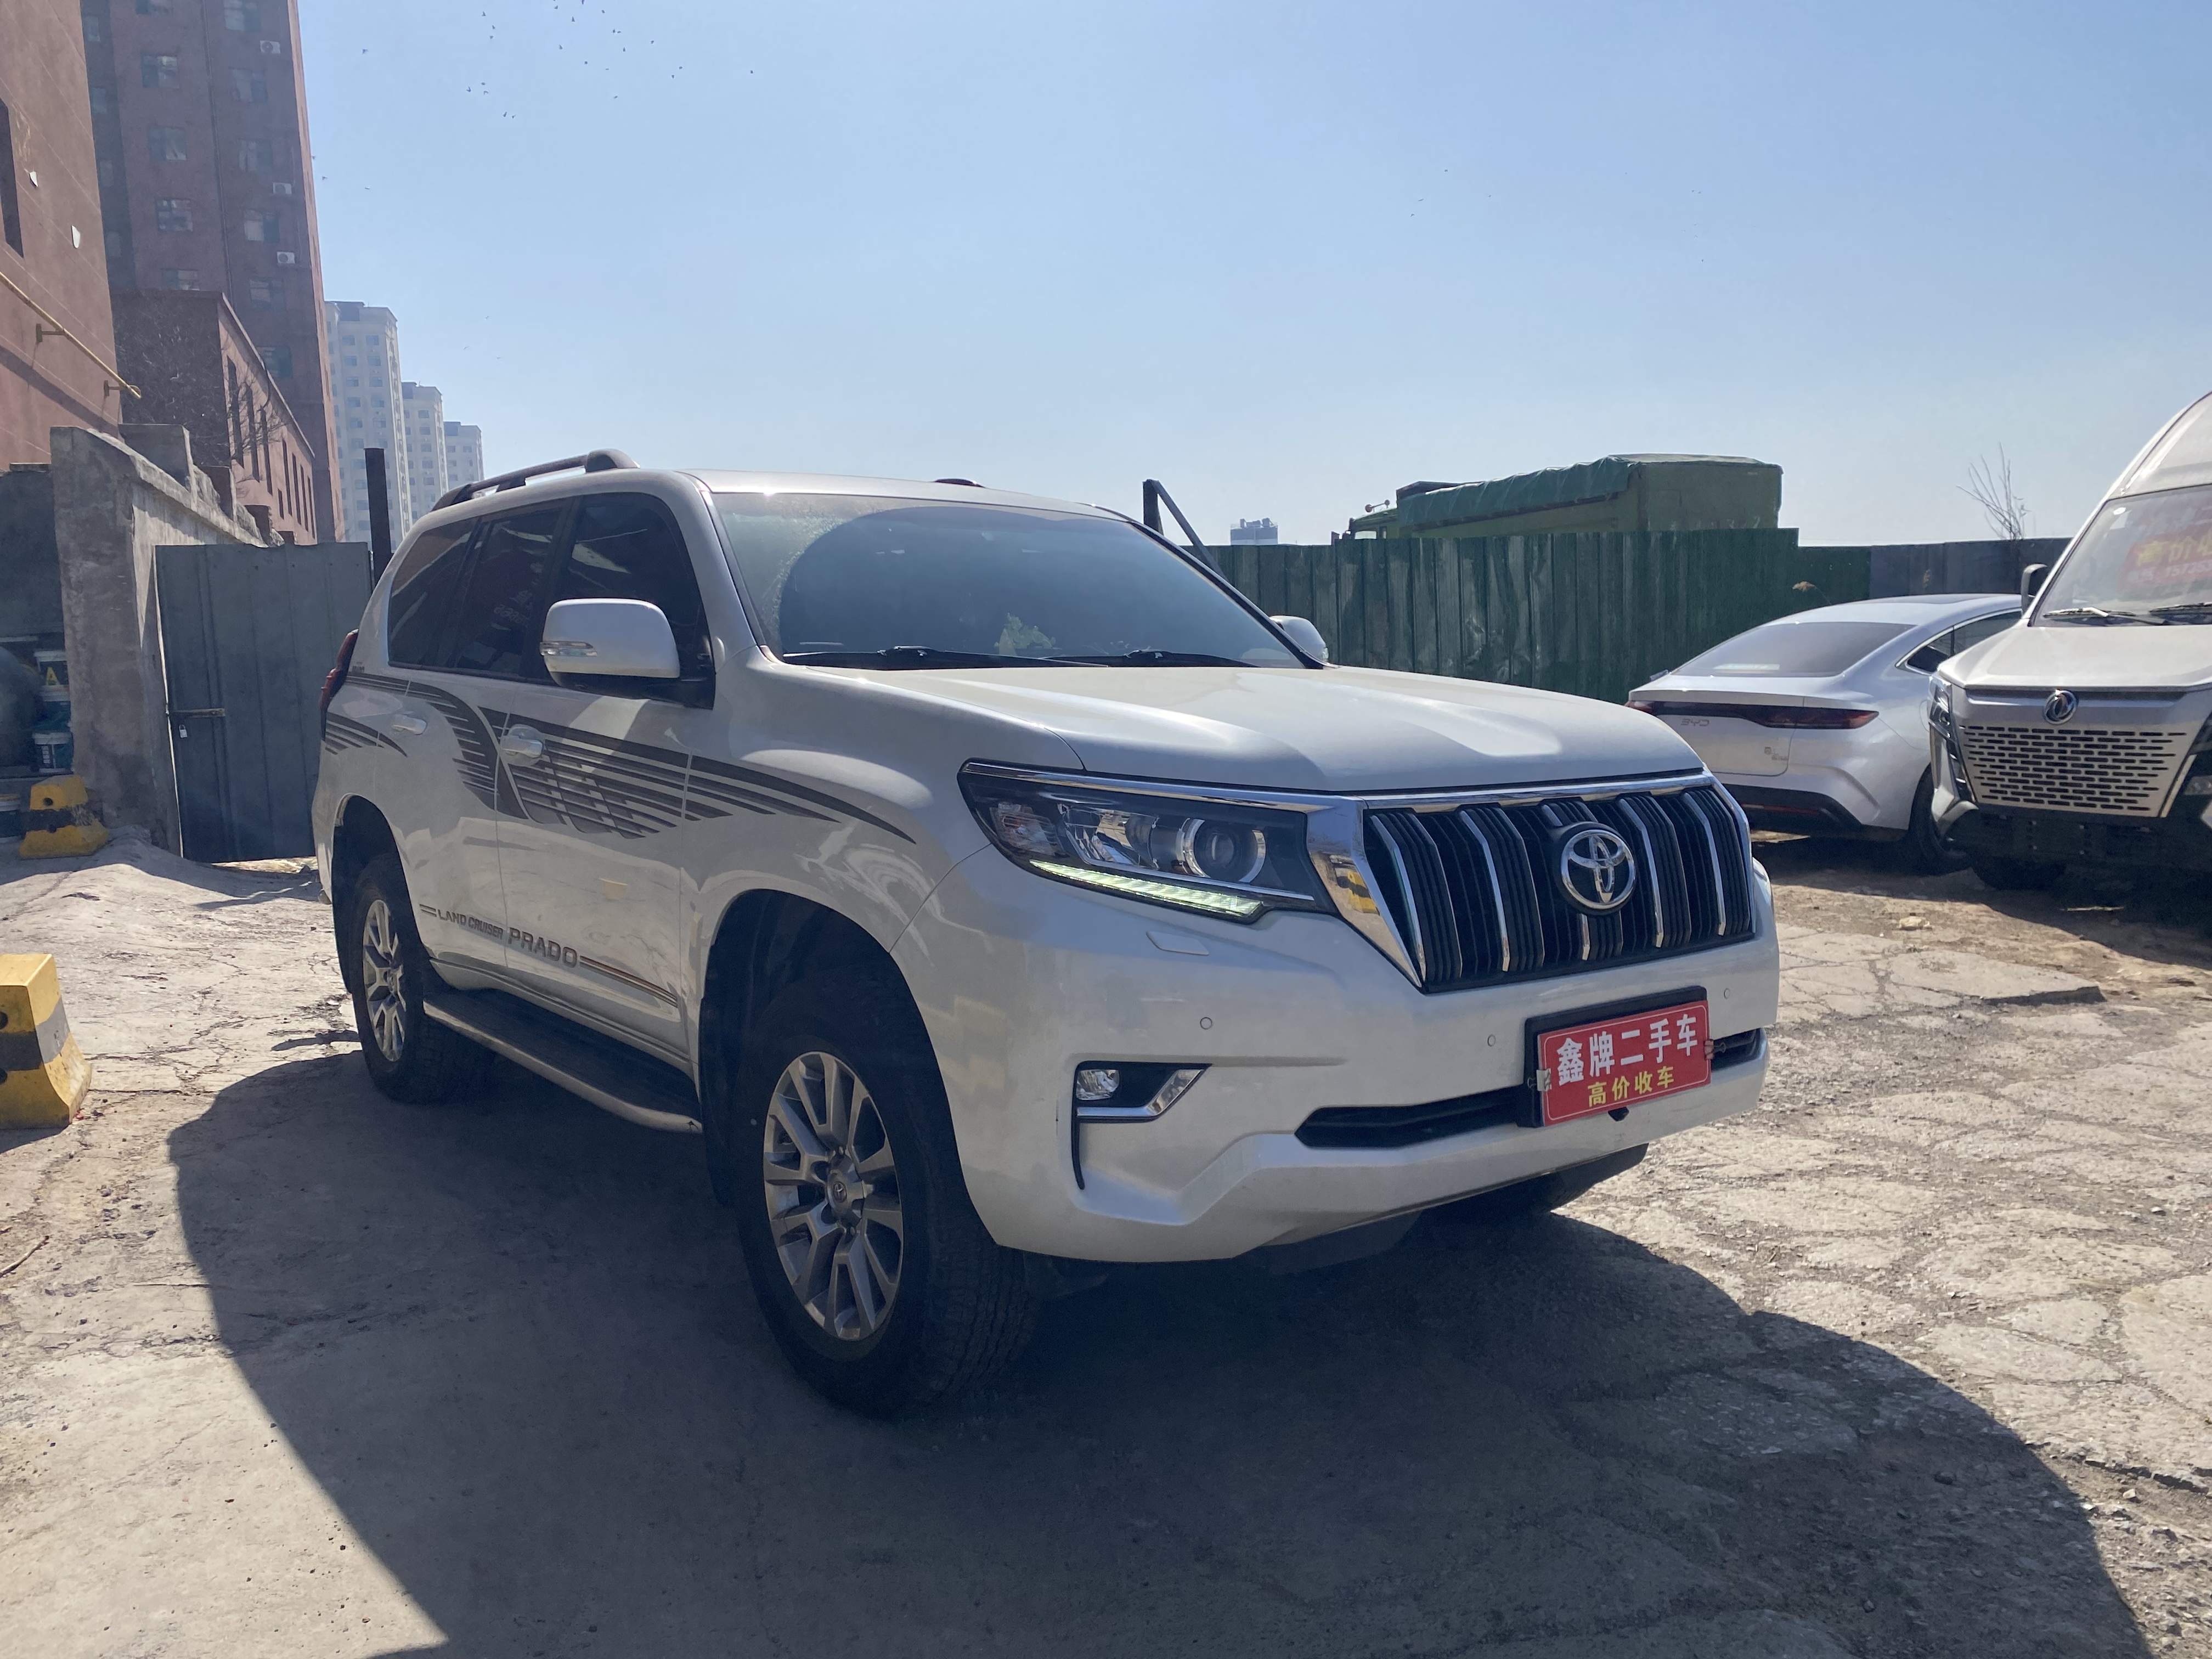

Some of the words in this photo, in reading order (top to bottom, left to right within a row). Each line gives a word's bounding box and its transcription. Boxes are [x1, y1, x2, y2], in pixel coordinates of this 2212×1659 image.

[438, 909, 466, 926] LAND
[468, 917, 503, 940] CRUISER
[508, 927, 577, 968] PRADO
[1556, 1014, 1698, 1086] 鑫牌二手车
[1588, 1065, 1674, 1107] 高价收车
